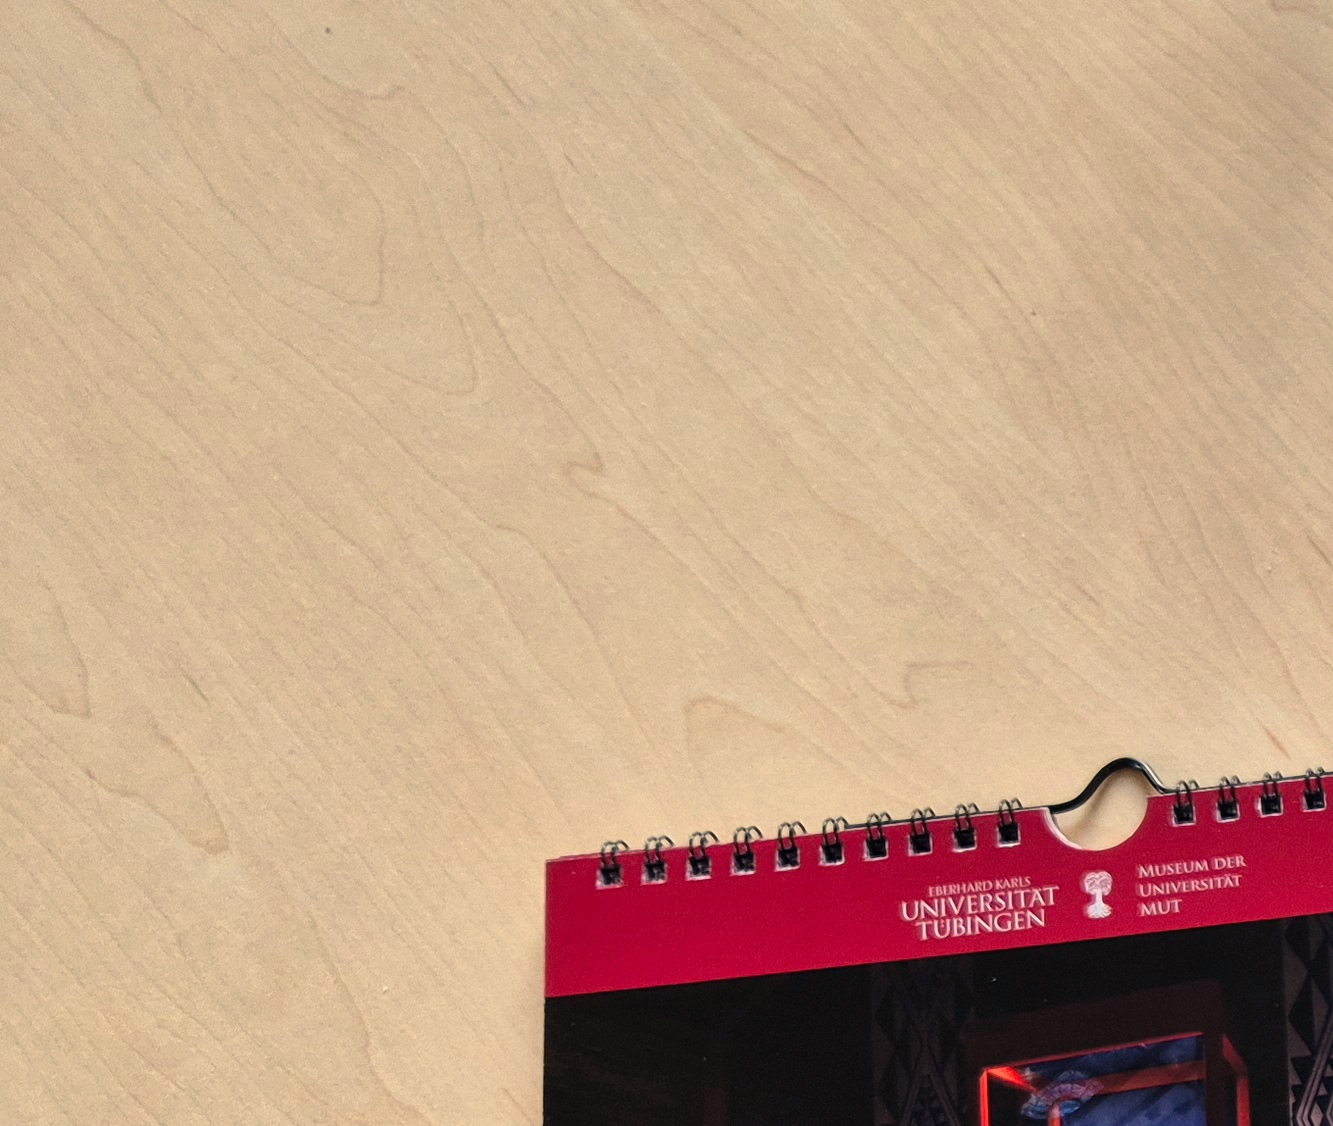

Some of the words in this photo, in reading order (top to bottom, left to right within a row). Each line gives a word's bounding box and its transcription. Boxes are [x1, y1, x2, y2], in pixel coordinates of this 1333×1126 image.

[1137, 859, 1209, 879] MUSEUM
[1214, 855, 1247, 870] DER
[928, 880, 994, 896] EBERHARD
[995, 875, 1031, 889] KARLS
[1137, 873, 1242, 898] UNIVERSITÄT
[901, 885, 1059, 921] UNIVERSITÄT
[1139, 899, 1183, 917] MUT
[915, 908, 1046, 940] TÜBINGEN
